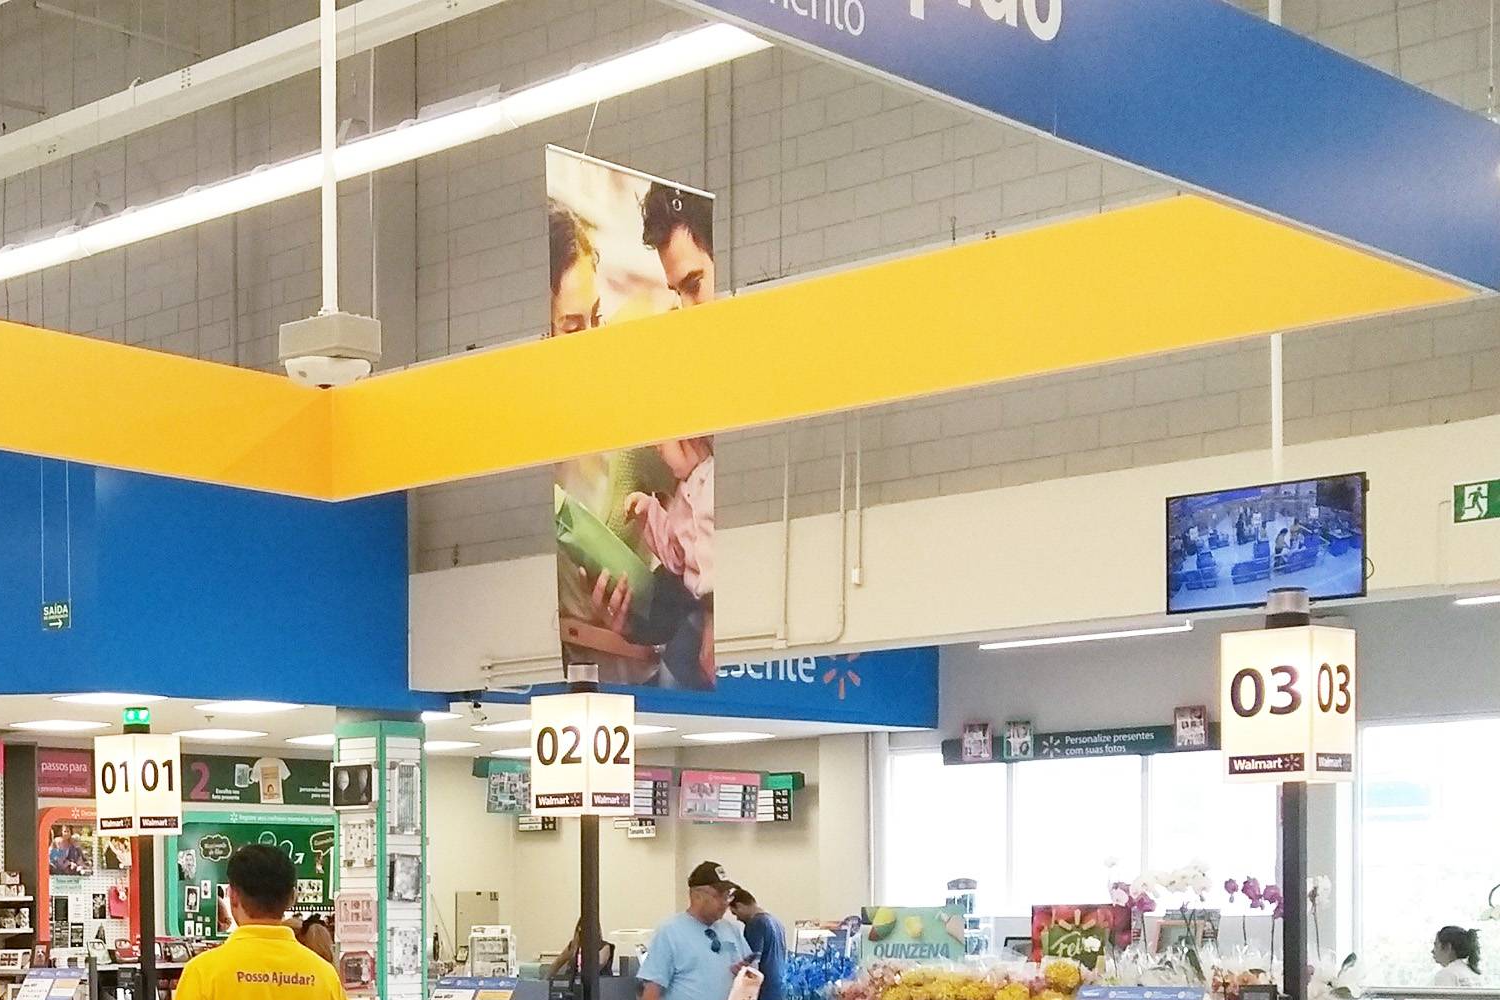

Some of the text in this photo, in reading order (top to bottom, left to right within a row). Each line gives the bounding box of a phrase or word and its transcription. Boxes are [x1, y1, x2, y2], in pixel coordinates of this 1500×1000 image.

[1230, 665, 1302, 717] 03
[1317, 662, 1351, 714] 03
[537, 726, 582, 765] 02
[593, 725, 630, 764] 02
[1065, 731, 1154, 745] Personalize presentes
[1066, 744, 1126, 756] com suas fotos
[41, 762, 88, 775] passos para
[1233, 757, 1282, 771] Walmart
[102, 761, 129, 794] 01
[141, 759, 173, 791] 01
[189, 761, 210, 800] 2
[538, 795, 570, 806] Walmart
[593, 794, 620, 805] Walmart
[102, 818, 124, 828] Walmart
[141, 817, 169, 827] Walmart
[873, 942, 951, 959] QUINZENA
[237, 971, 316, 986] Posso Ajudar?
